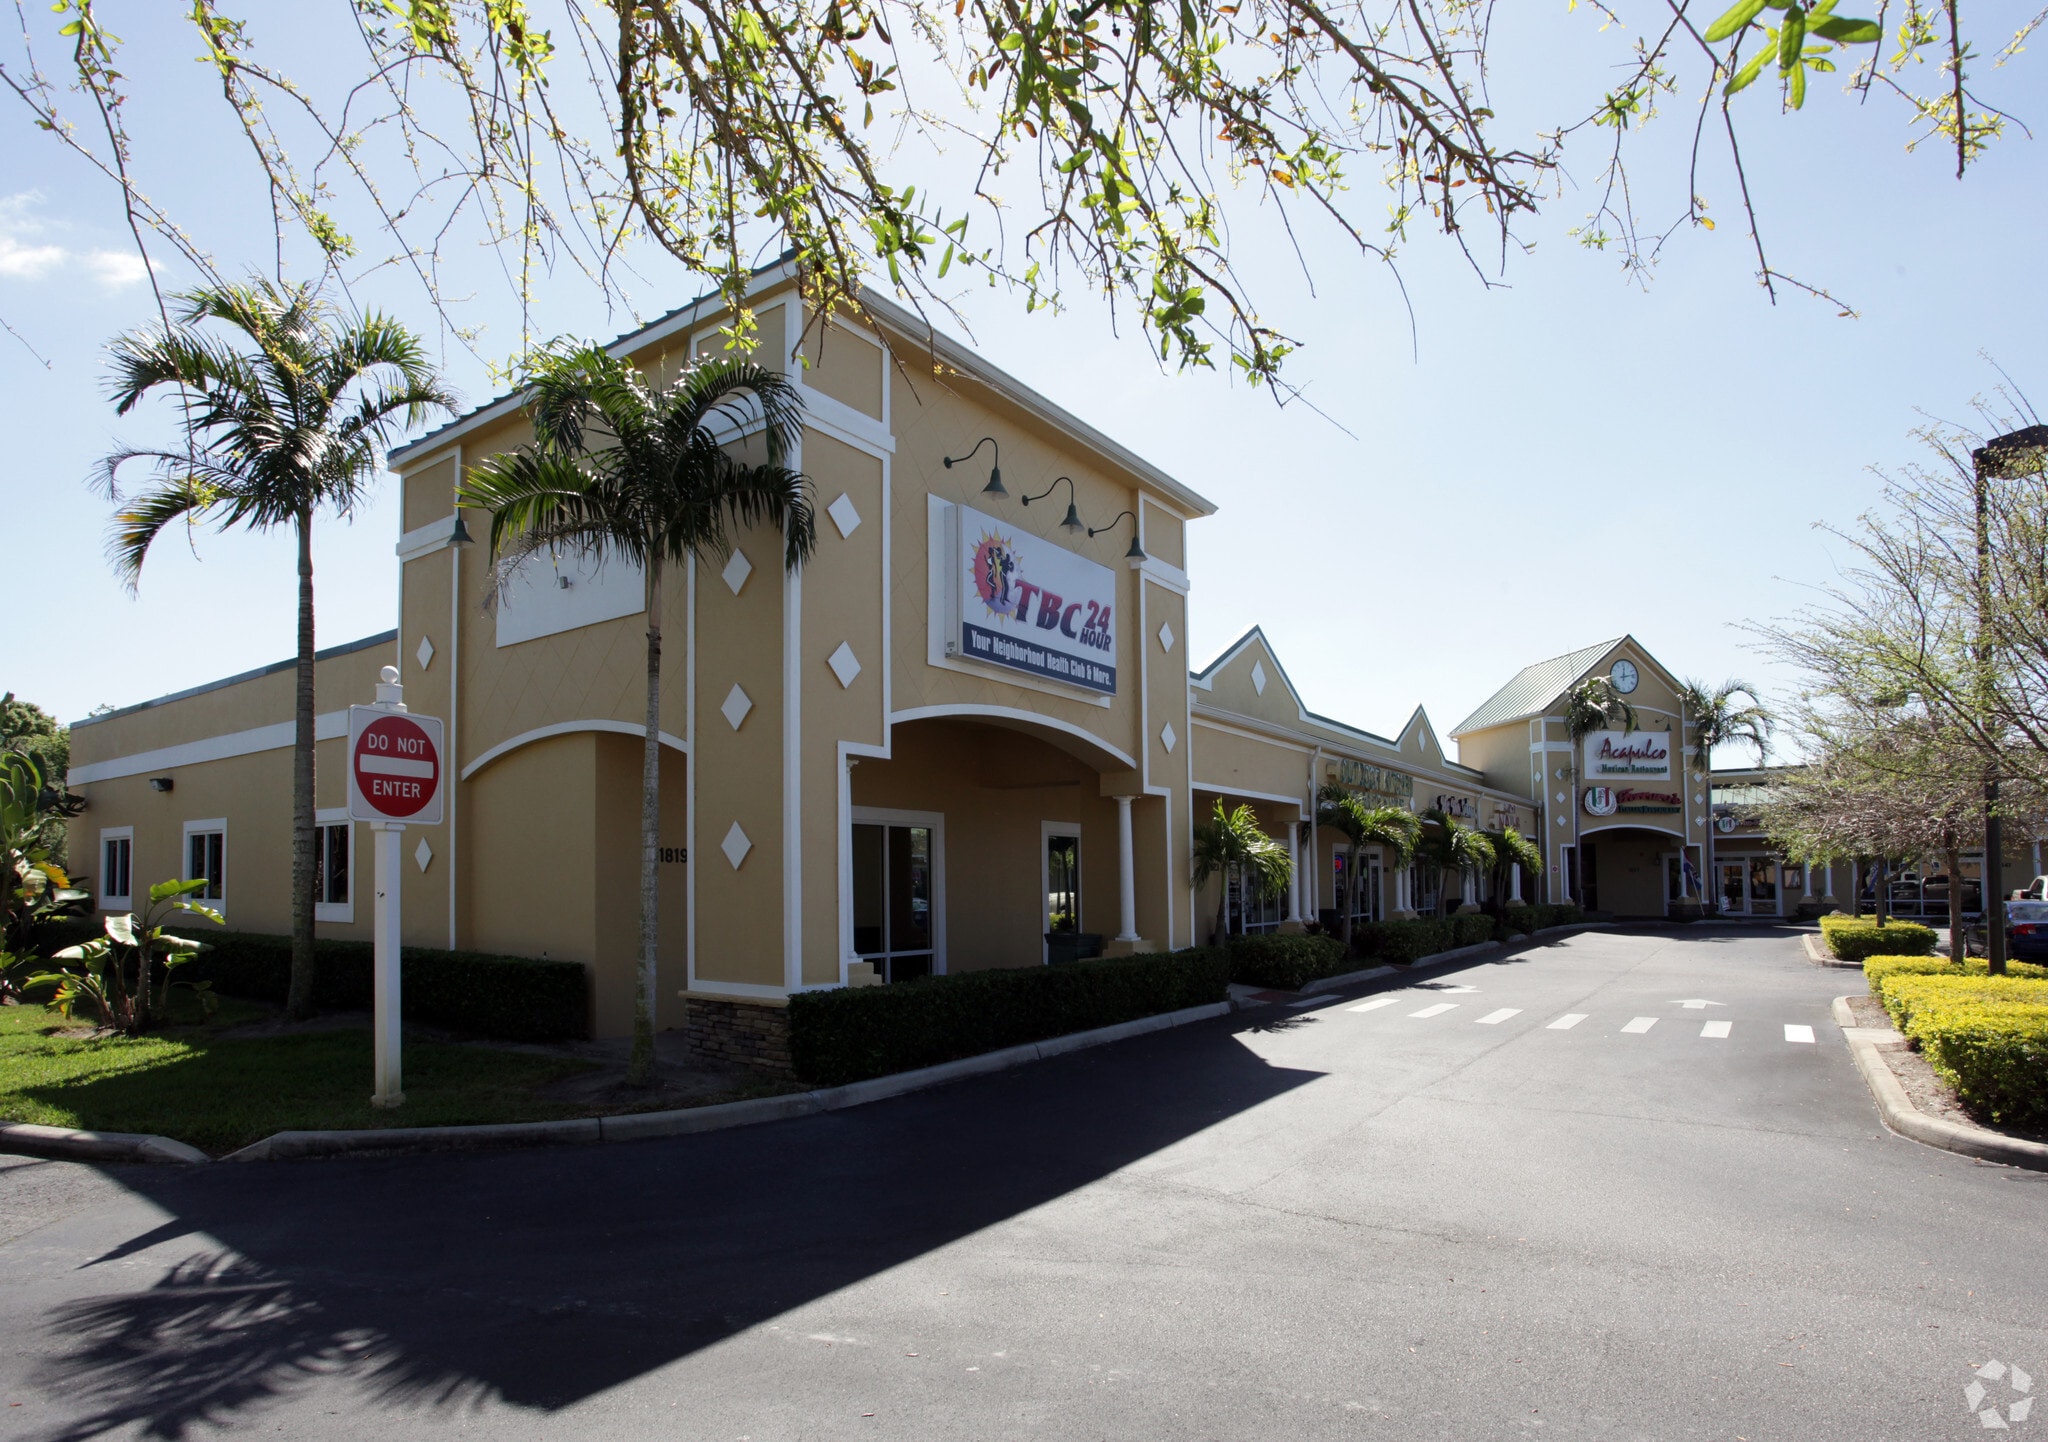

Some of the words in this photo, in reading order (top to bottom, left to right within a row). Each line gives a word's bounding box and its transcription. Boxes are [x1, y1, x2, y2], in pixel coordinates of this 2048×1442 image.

[1015, 578, 1082, 640] TBC
[1084, 598, 1112, 634] 24
[1079, 628, 1112, 652] HOUR
[971, 630, 991, 652] Your
[993, 636, 1045, 668] Neighborhood
[1047, 653, 1069, 675] Health
[1070, 660, 1086, 679] Club
[1086, 665, 1092, 680] &
[368, 733, 388, 751] DO
[398, 737, 425, 755] NOT
[1600, 737, 1667, 765] Acapulco
[1601, 764, 1629, 774] Mexican
[1631, 764, 1668, 774] Restaurant
[373, 780, 420, 798] ENTER
[659, 847, 688, 864] 1819
